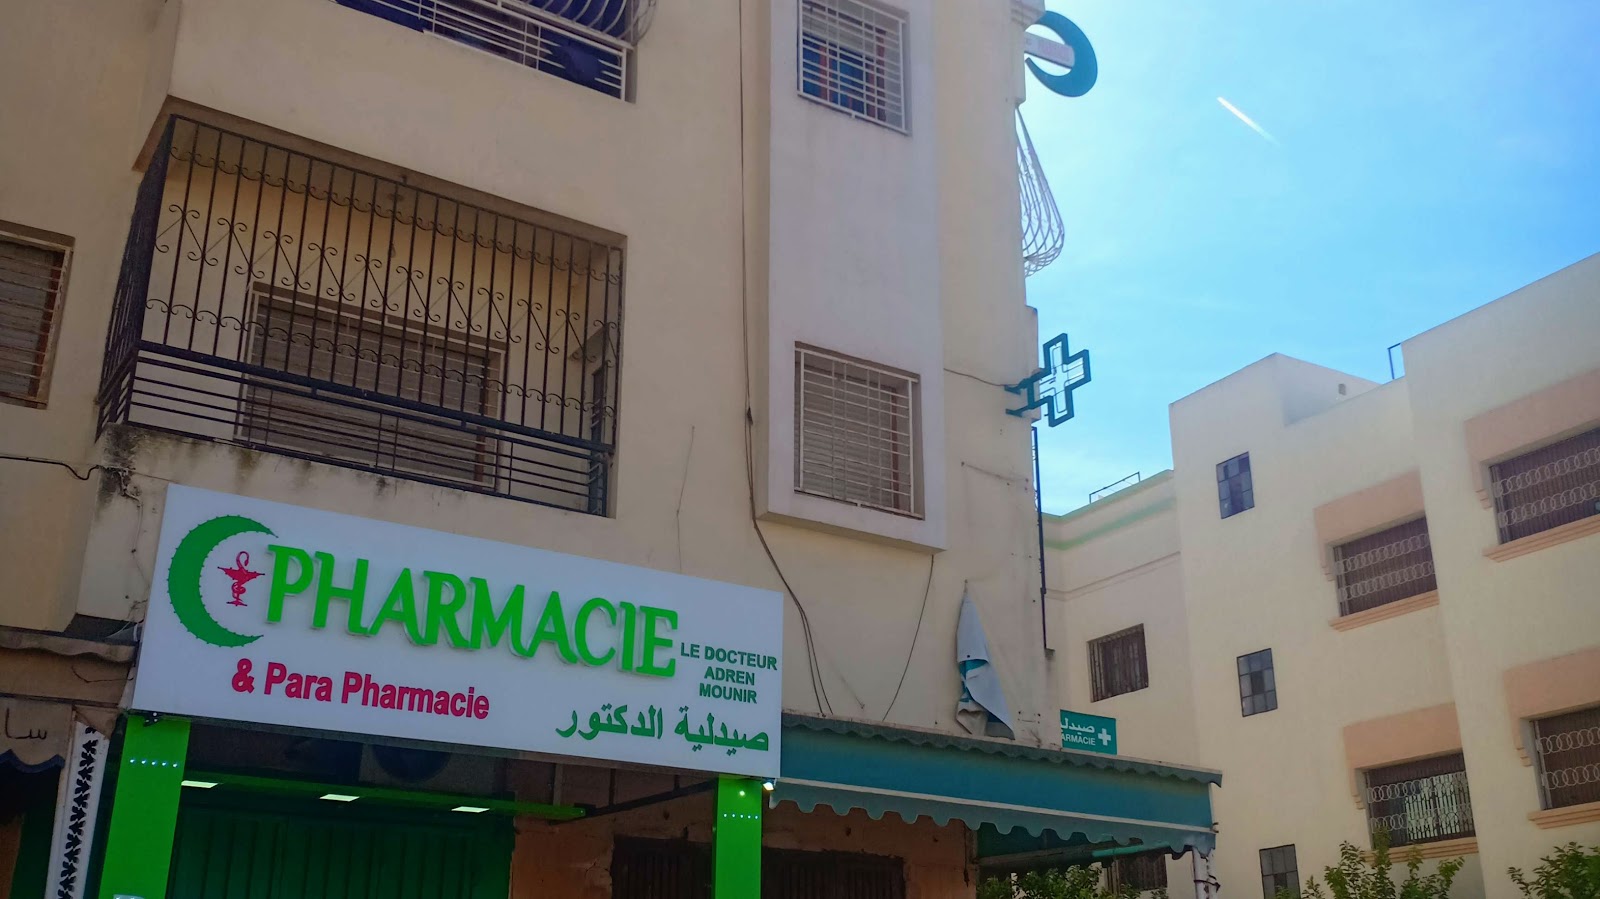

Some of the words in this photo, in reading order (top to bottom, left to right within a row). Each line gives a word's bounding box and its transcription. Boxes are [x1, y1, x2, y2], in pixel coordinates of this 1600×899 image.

[266, 544, 678, 678] PHARMACIE
[680, 642, 700, 659] LE
[704, 646, 778, 671] DOCTEUR
[231, 657, 255, 693] &
[263, 661, 334, 703] Para
[340, 671, 490, 720] Pharmacie
[699, 683, 758, 704] MOUNIR
[704, 666, 755, 687] ADREN
[555, 703, 664, 741] الدكتور
[674, 705, 770, 756] صيدلية
